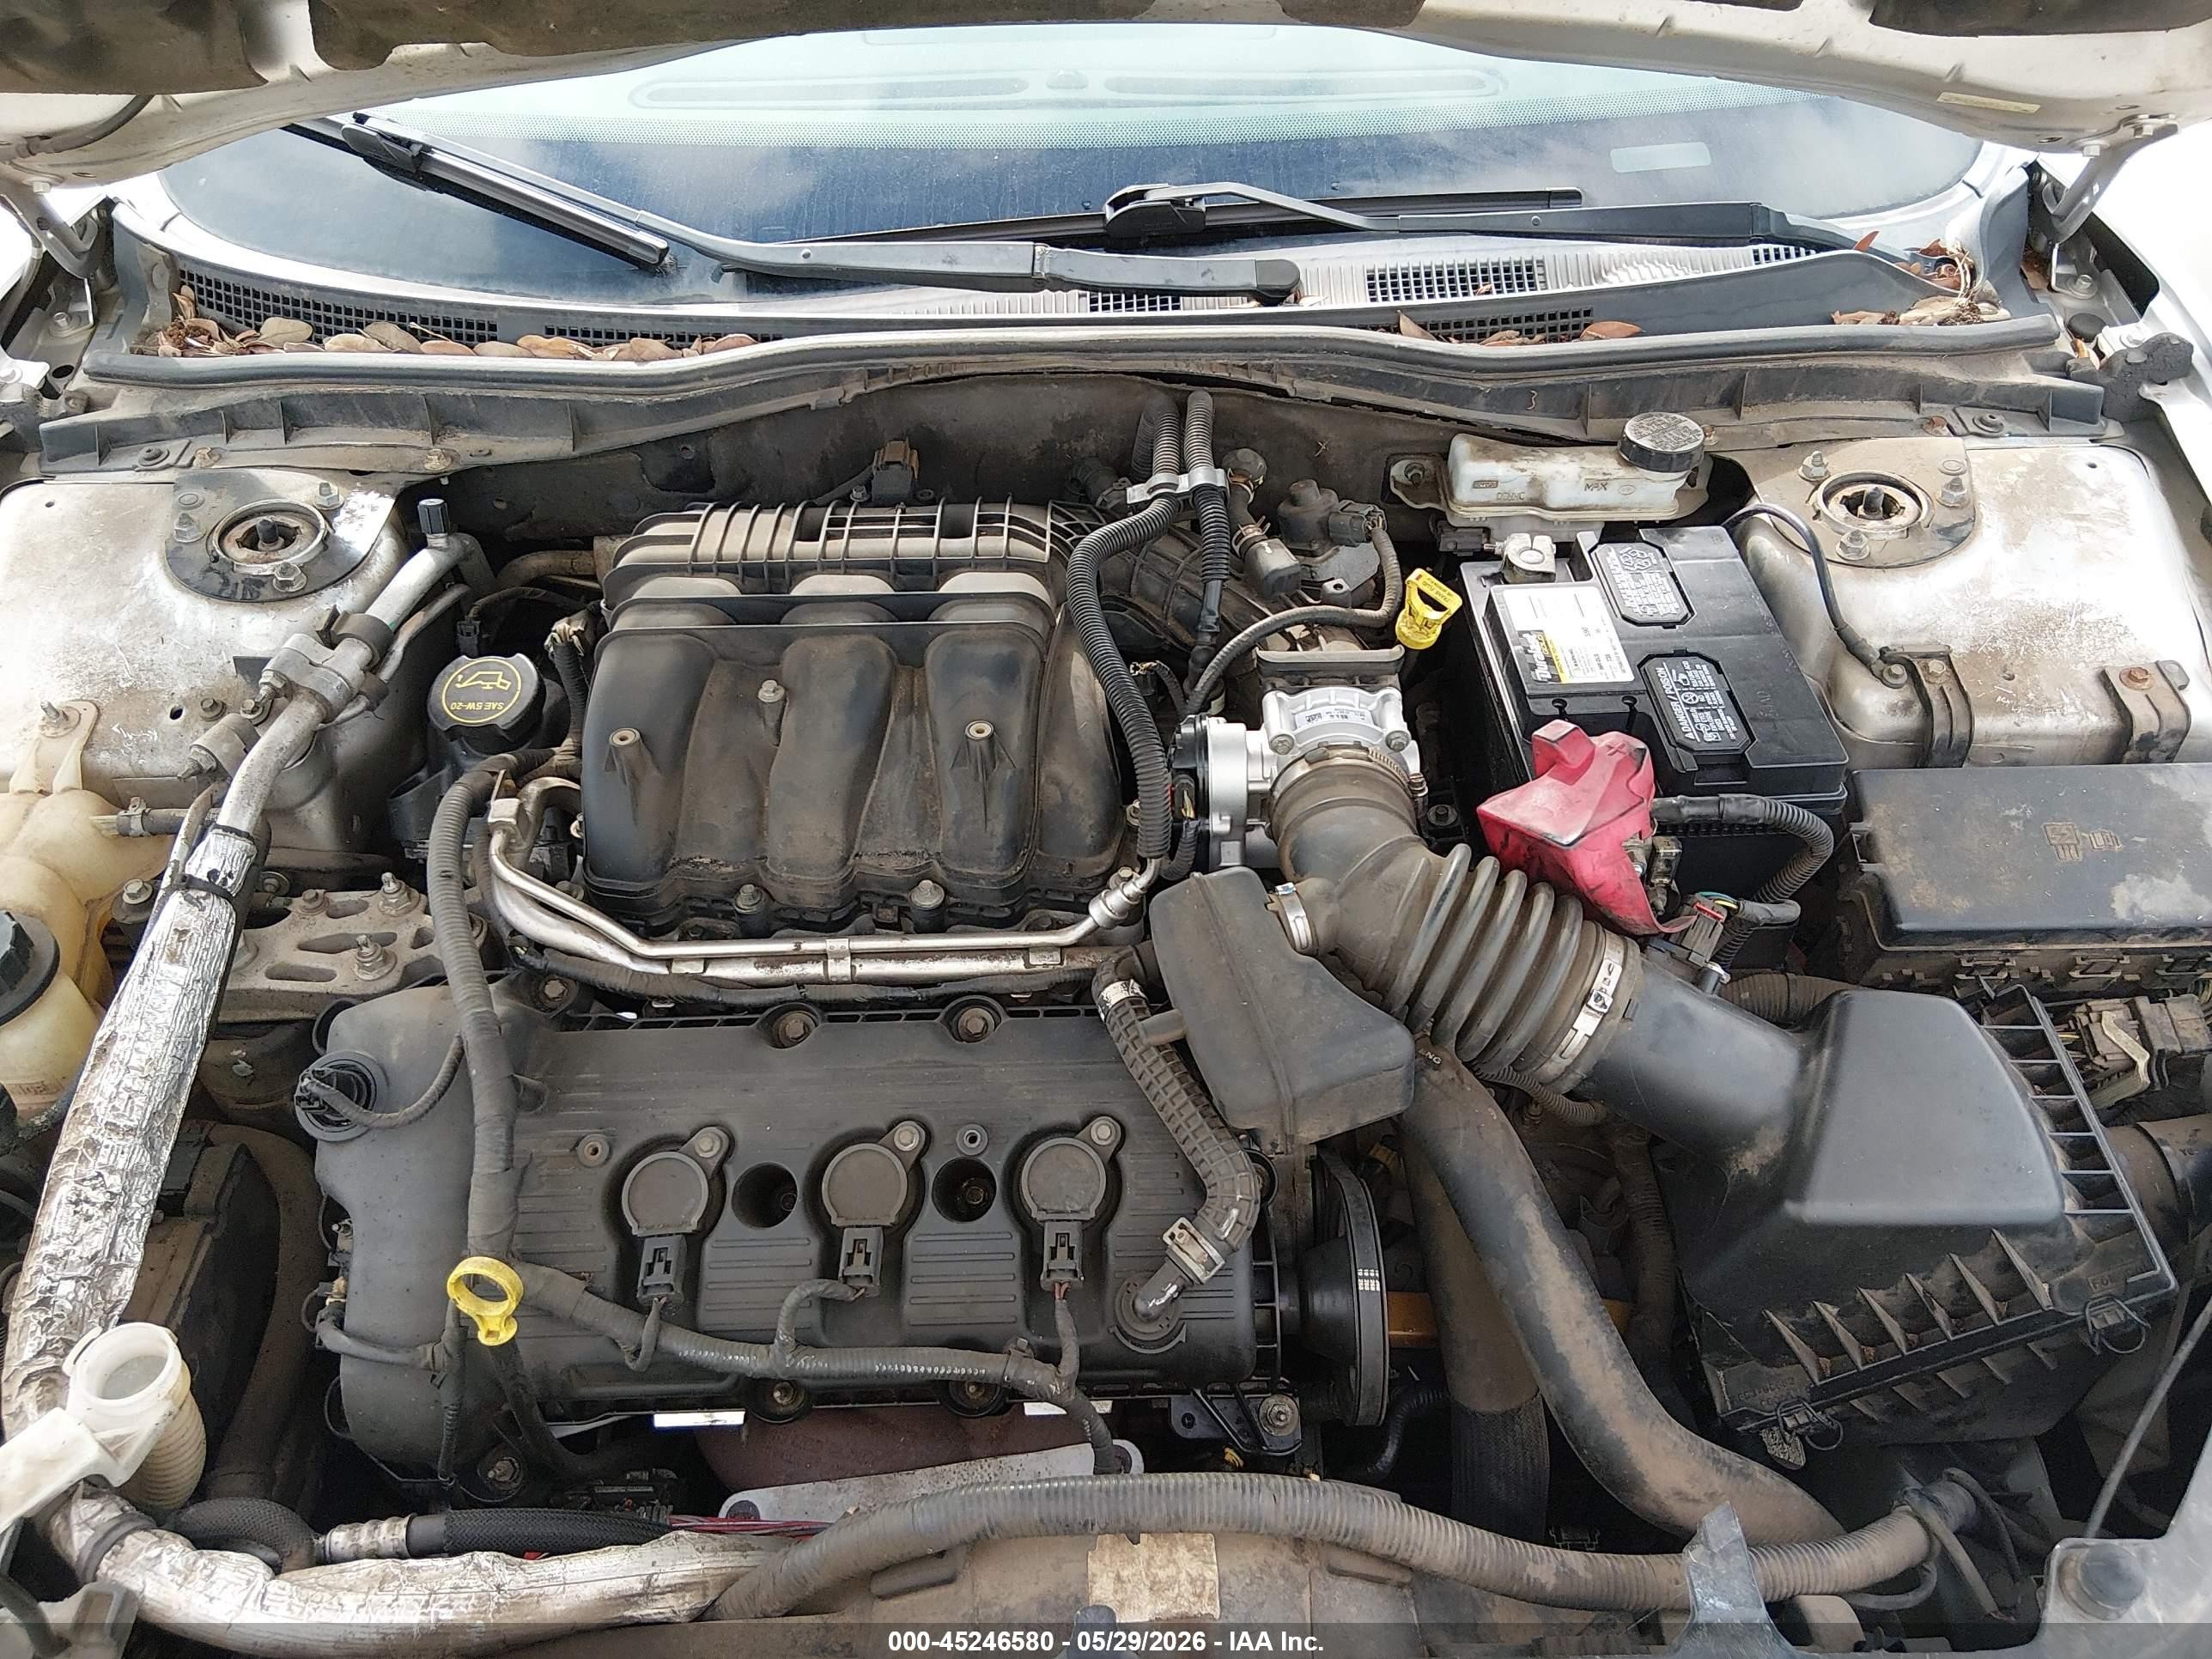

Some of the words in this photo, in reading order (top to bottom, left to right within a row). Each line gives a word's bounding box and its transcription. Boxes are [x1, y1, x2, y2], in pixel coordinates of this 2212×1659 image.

[1655, 667, 1675, 695] POISON
[451, 702, 483, 710] 5W-20
[484, 702, 504, 710] SAE
[1669, 701, 1692, 732] DANGER
